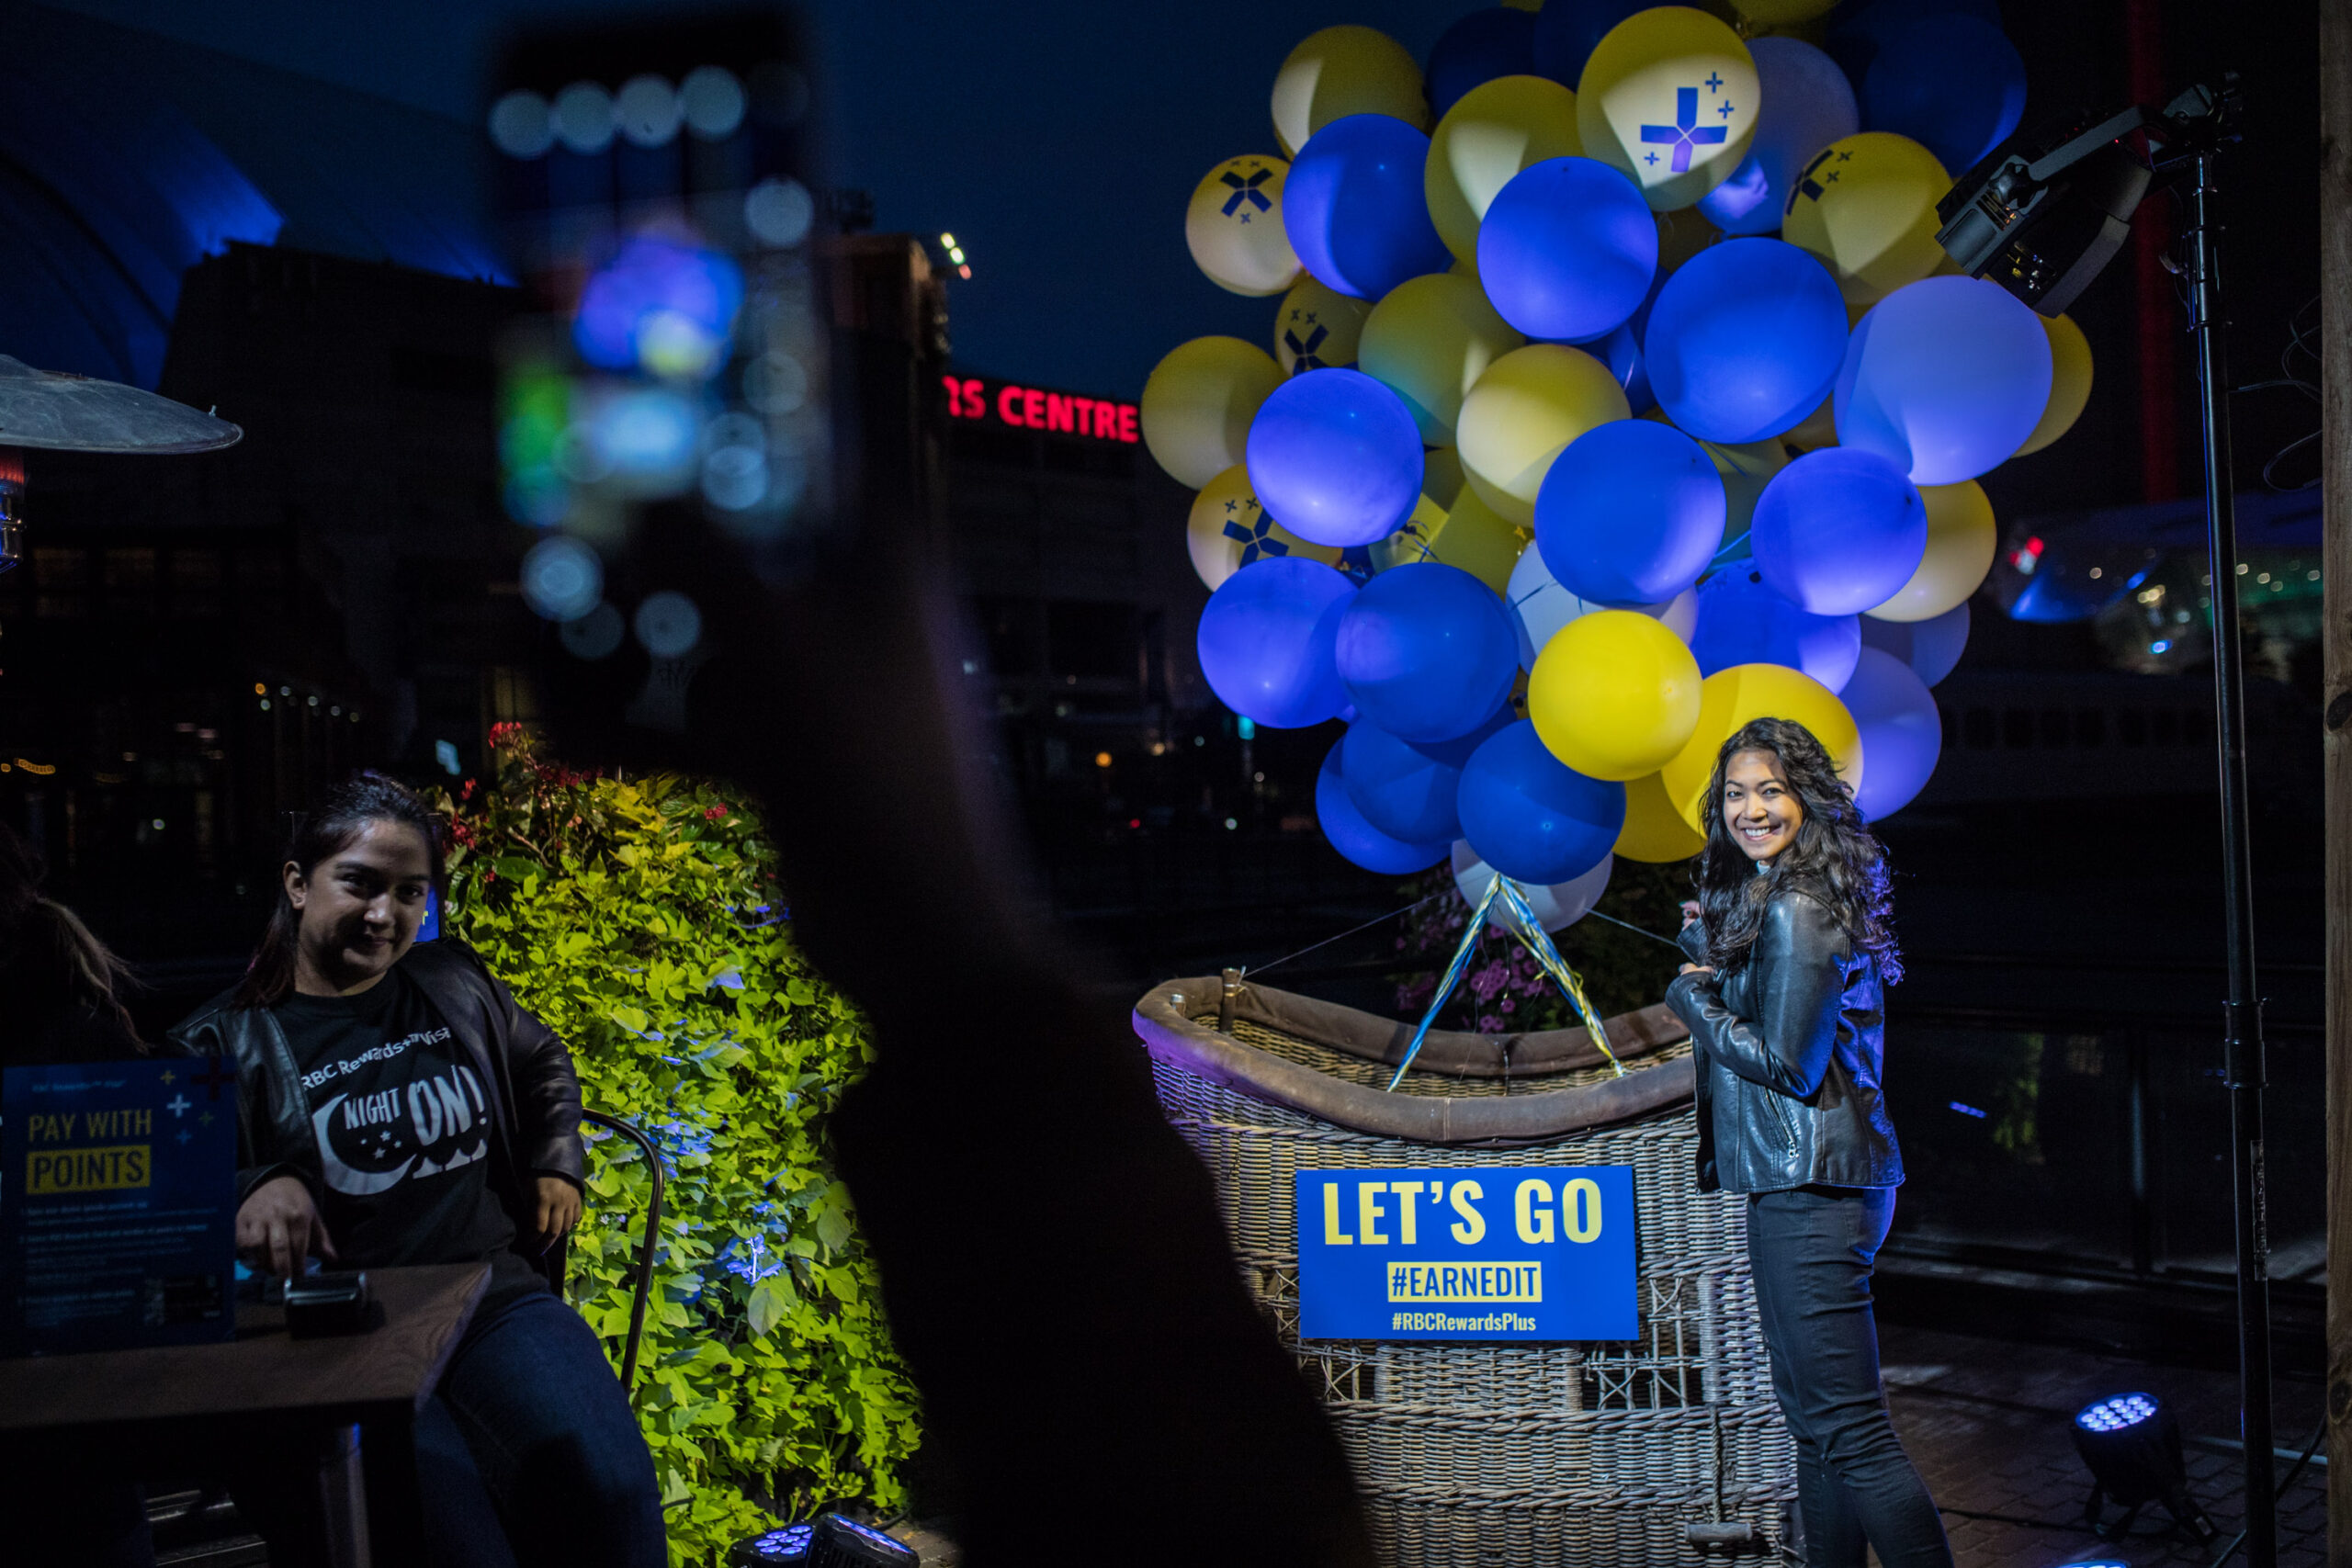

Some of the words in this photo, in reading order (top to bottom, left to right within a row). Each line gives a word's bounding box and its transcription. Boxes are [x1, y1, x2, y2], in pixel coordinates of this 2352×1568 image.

[998, 385, 1139, 444] CENTRE
[300, 1063, 338, 1090] RBC
[344, 1088, 401, 1130] NIGHT
[407, 1064, 485, 1146] ON!
[28, 1112, 76, 1143] PAY
[86, 1109, 153, 1138] WITH
[33, 1150, 144, 1190] POINTS
[1323, 1179, 1486, 1246] LET’S
[1515, 1178, 1602, 1245] GO
[1392, 1266, 1538, 1297] #EARNEDIT
[1392, 1311, 1536, 1332] #RBCRewardsPlus
